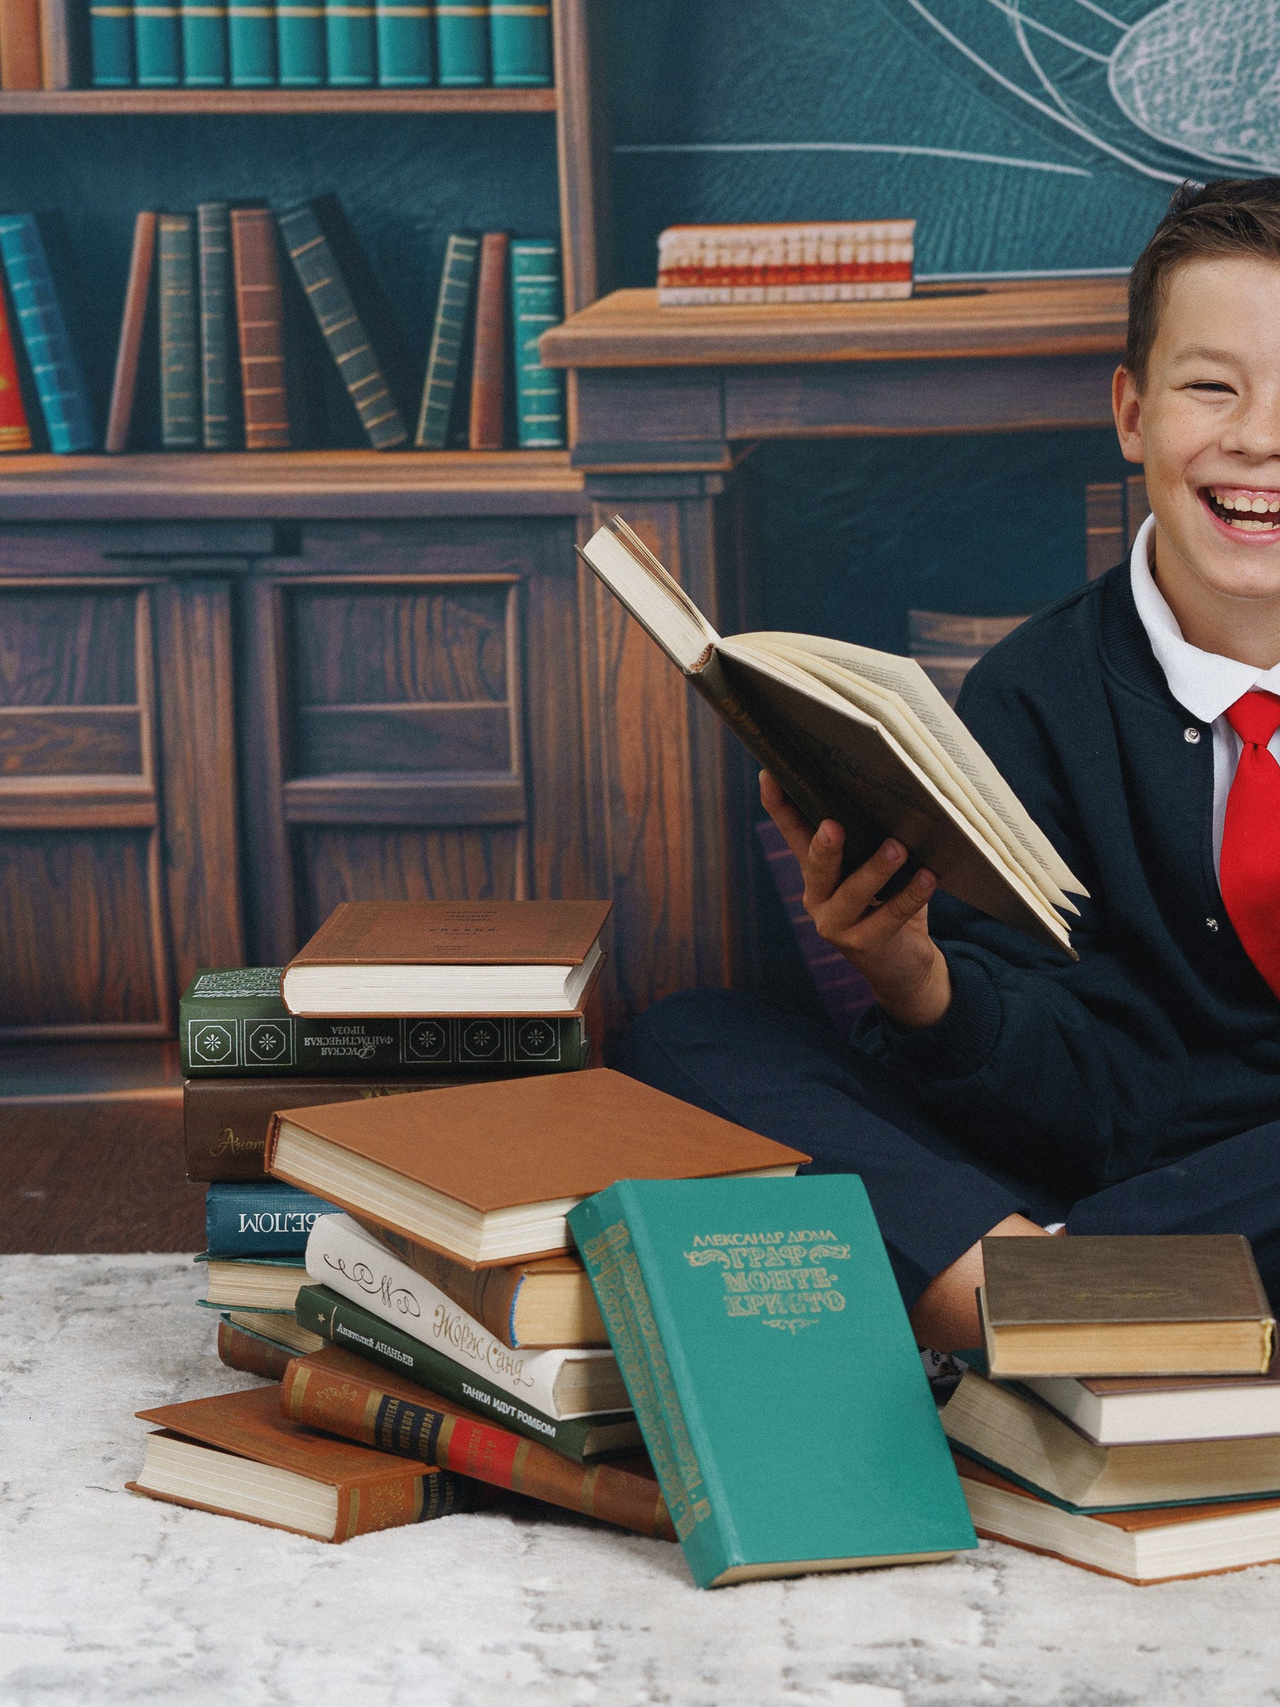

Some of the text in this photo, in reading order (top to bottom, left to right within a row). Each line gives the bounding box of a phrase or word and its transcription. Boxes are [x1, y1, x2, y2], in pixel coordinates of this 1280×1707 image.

[304, 1035, 394, 1046] ФАНТАСТИЧЕСКАЯ
[330, 1025, 365, 1035] ПРОЗА
[321, 1044, 376, 1059] РУССКАЯ
[238, 1212, 322, 1233] БЕЛОМ
[693, 1229, 838, 1247] АЛЕКСАНДР ДЮМА
[727, 1245, 807, 1269] ГРАФ
[723, 1290, 846, 1317] КРИСТО
[336, 1322, 414, 1367] Анатолий АНАНЬЕВ
[433, 1304, 535, 1388] Жорж Санд
[462, 1382, 557, 1438] ТАНКИ ИДУТ РОМБОМ
